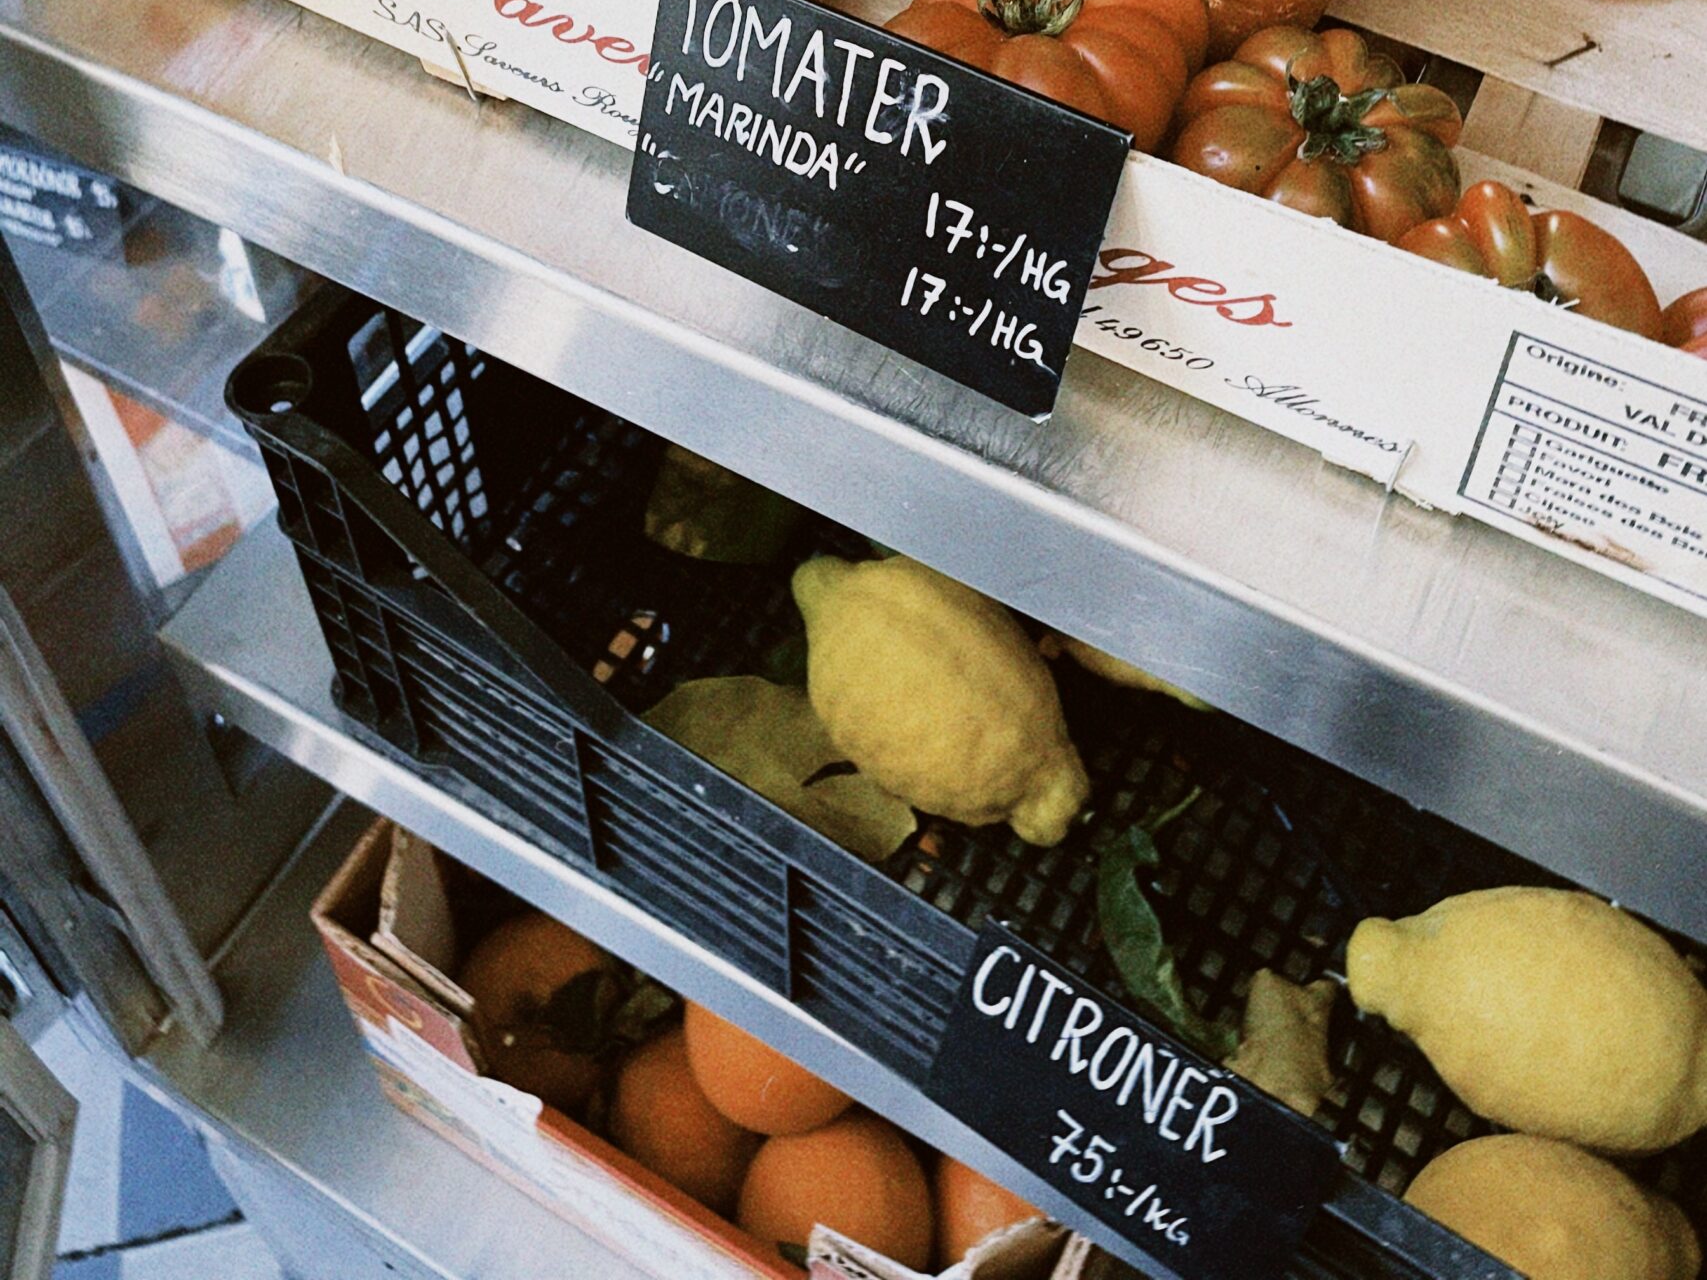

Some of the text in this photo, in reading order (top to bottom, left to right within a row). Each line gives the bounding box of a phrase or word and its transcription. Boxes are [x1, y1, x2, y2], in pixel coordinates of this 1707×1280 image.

[1095, 319, 1215, 370] 49650
[1527, 345, 1628, 392] Origine:
[1625, 404, 1676, 438] VAL
[1540, 452, 1612, 487] Favori
[1531, 478, 1613, 519] Fraises
[1621, 519, 1663, 539] des
[1600, 494, 1642, 515] des
[1650, 512, 1702, 540] Bois
[972, 946, 1239, 1164] CITRONER
